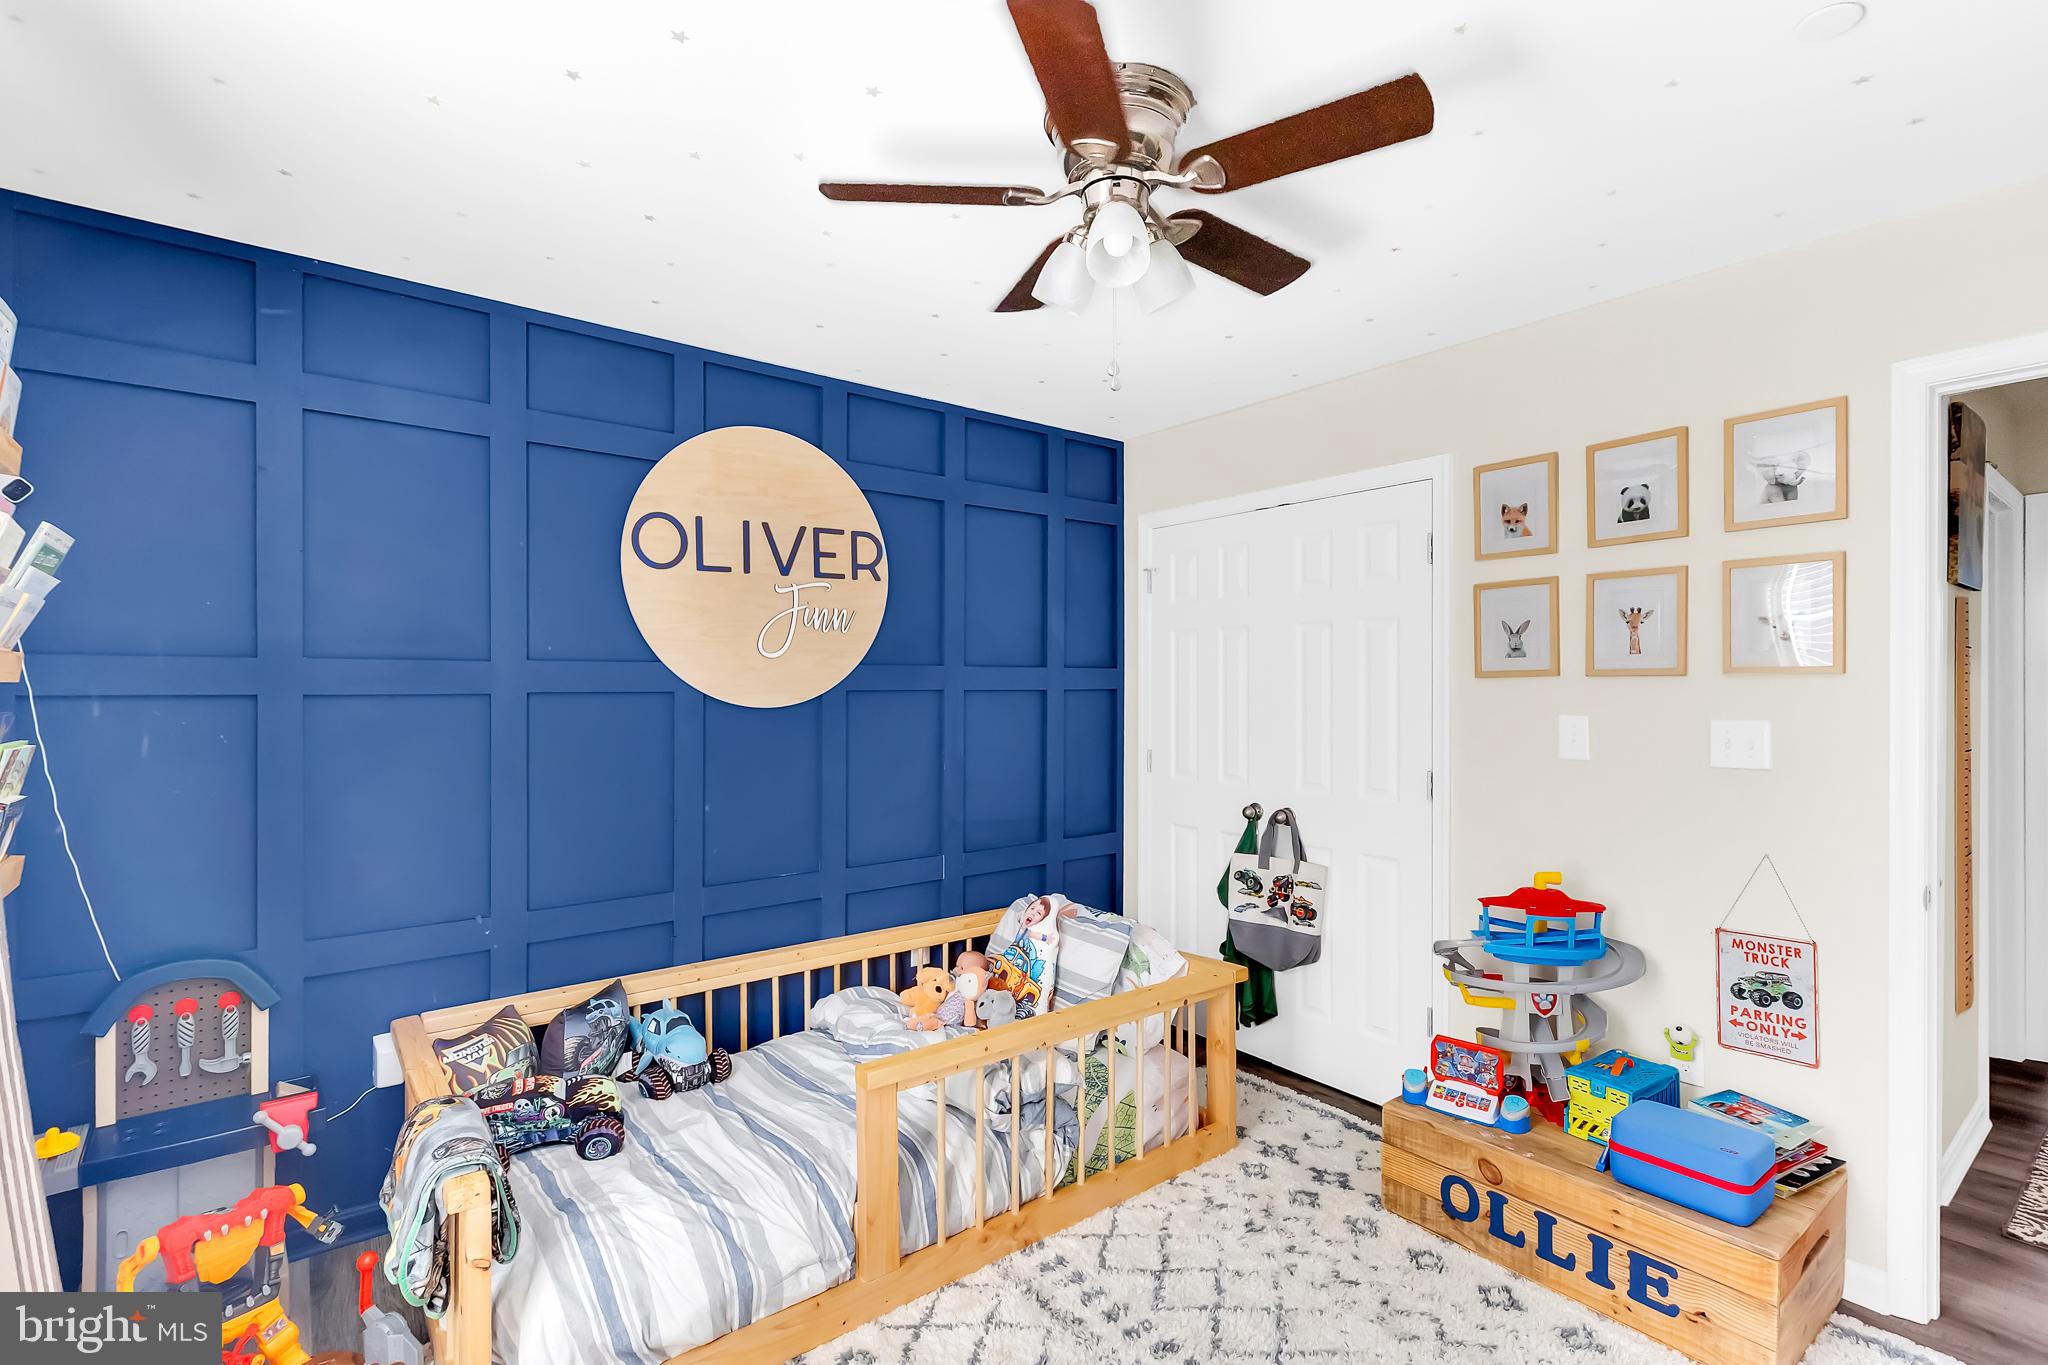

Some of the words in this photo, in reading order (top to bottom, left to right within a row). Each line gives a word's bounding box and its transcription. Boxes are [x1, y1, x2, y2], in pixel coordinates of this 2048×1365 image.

[631, 511, 884, 582] OLIVER
[756, 582, 856, 660] Finn
[1732, 938, 1802, 959] MONSTER
[1744, 951, 1790, 969] TRUCK
[1730, 1005, 1807, 1029] PARKING
[1738, 1032, 1779, 1045] VIOLATORS
[1780, 1041, 1799, 1050] WILL
[1746, 1021, 1791, 1039] ONLY
[442, 1037, 495, 1064] MONSTER
[1756, 1043, 1792, 1055] SMASHED
[1441, 1174, 1680, 1317] OLLIE
